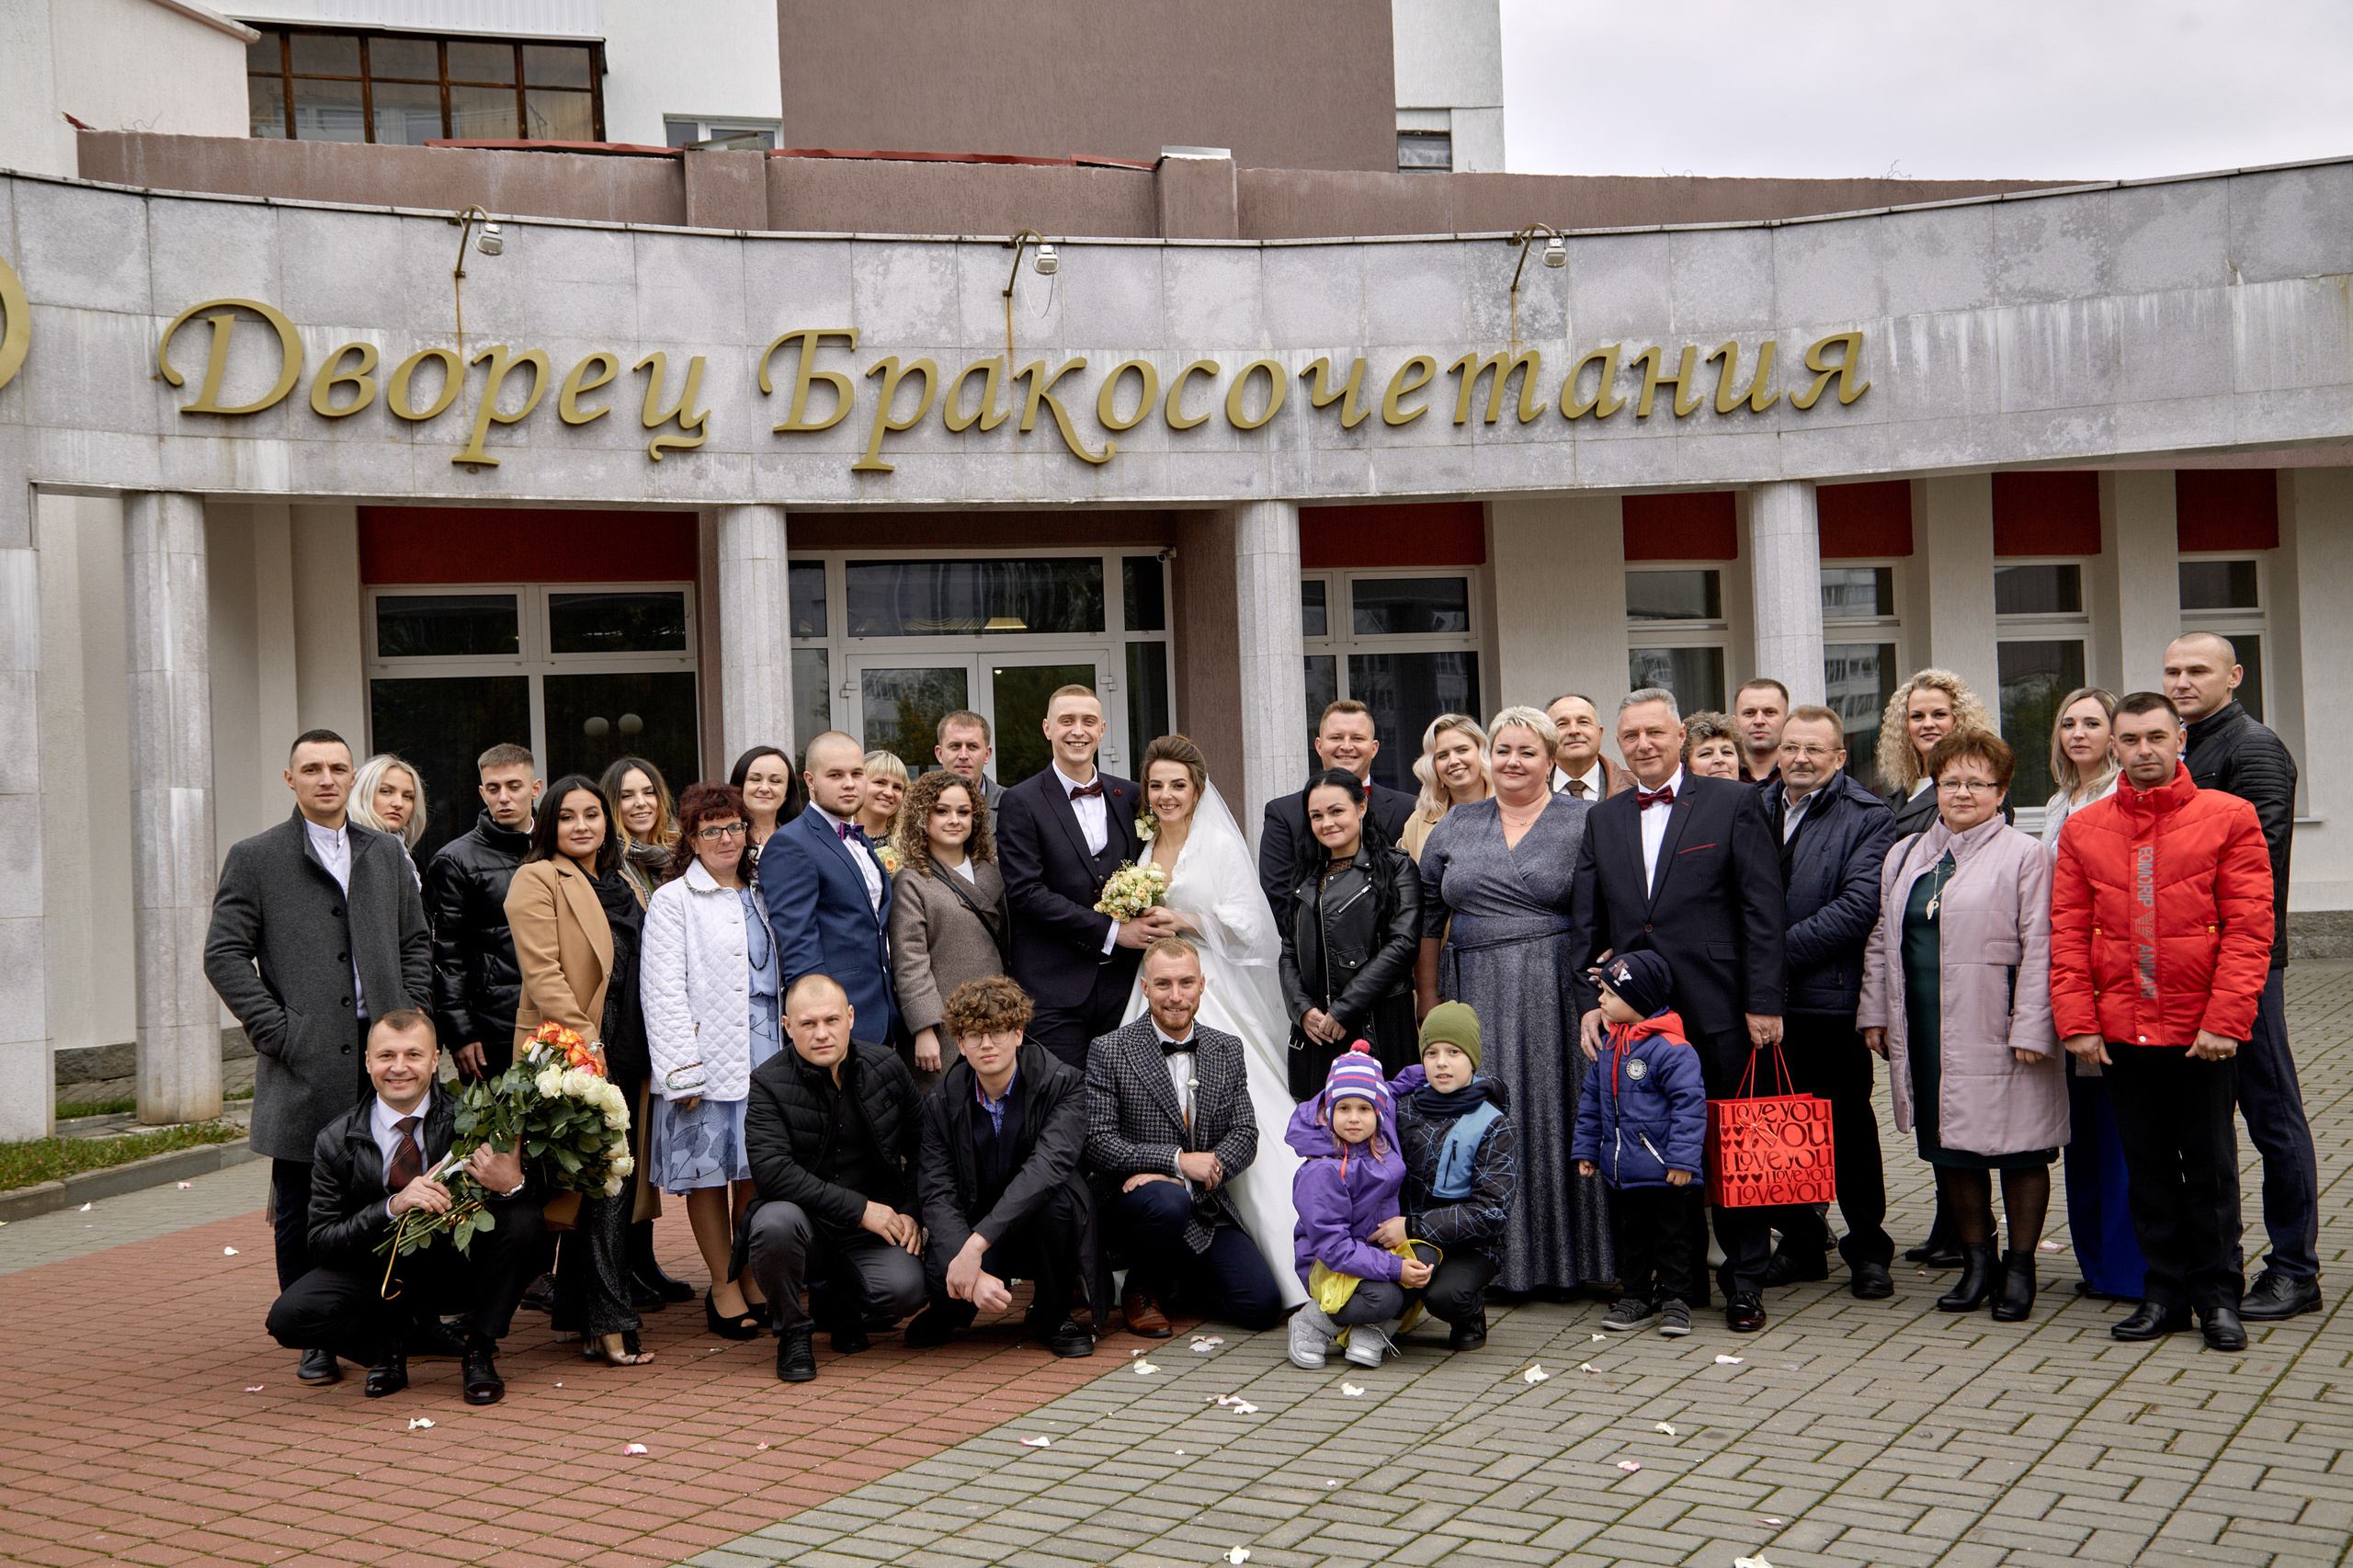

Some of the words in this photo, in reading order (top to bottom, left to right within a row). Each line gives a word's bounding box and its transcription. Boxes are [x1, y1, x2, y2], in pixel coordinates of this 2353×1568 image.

[158, 298, 712, 468] Дворец
[758, 326, 1872, 473] Бракосочетания
[2137, 846, 2154, 907] EOMORIP
[2138, 944, 2157, 999] ANMARI
[1780, 1102, 1831, 1123] you
[1785, 1148, 1833, 1170] you
[1805, 1167, 1835, 1182] you
[1787, 1182, 1836, 1203] you
